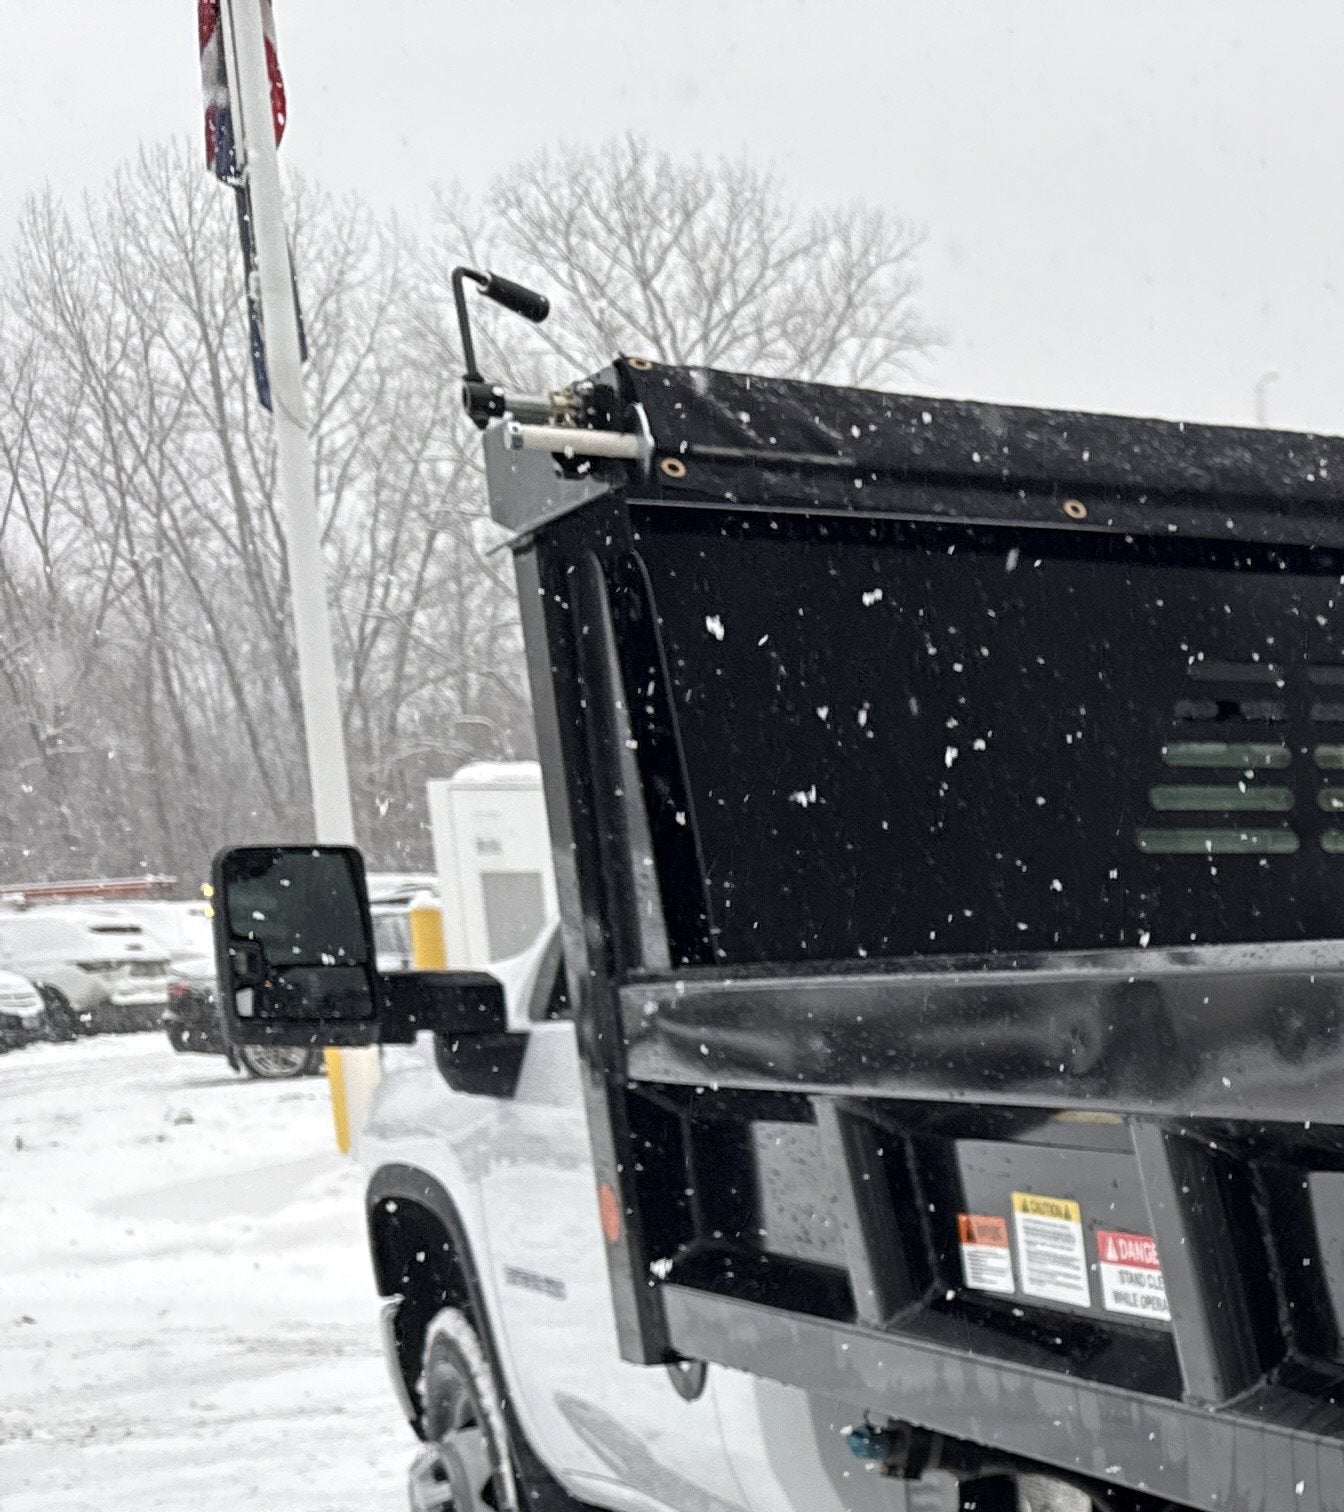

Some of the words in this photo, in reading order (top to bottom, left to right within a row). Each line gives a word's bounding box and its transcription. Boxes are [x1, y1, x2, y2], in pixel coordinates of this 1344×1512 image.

[1118, 1237, 1160, 1266] DANGE
[1147, 1273, 1165, 1291] CLE
[1140, 1294, 1170, 1313] OPERA
